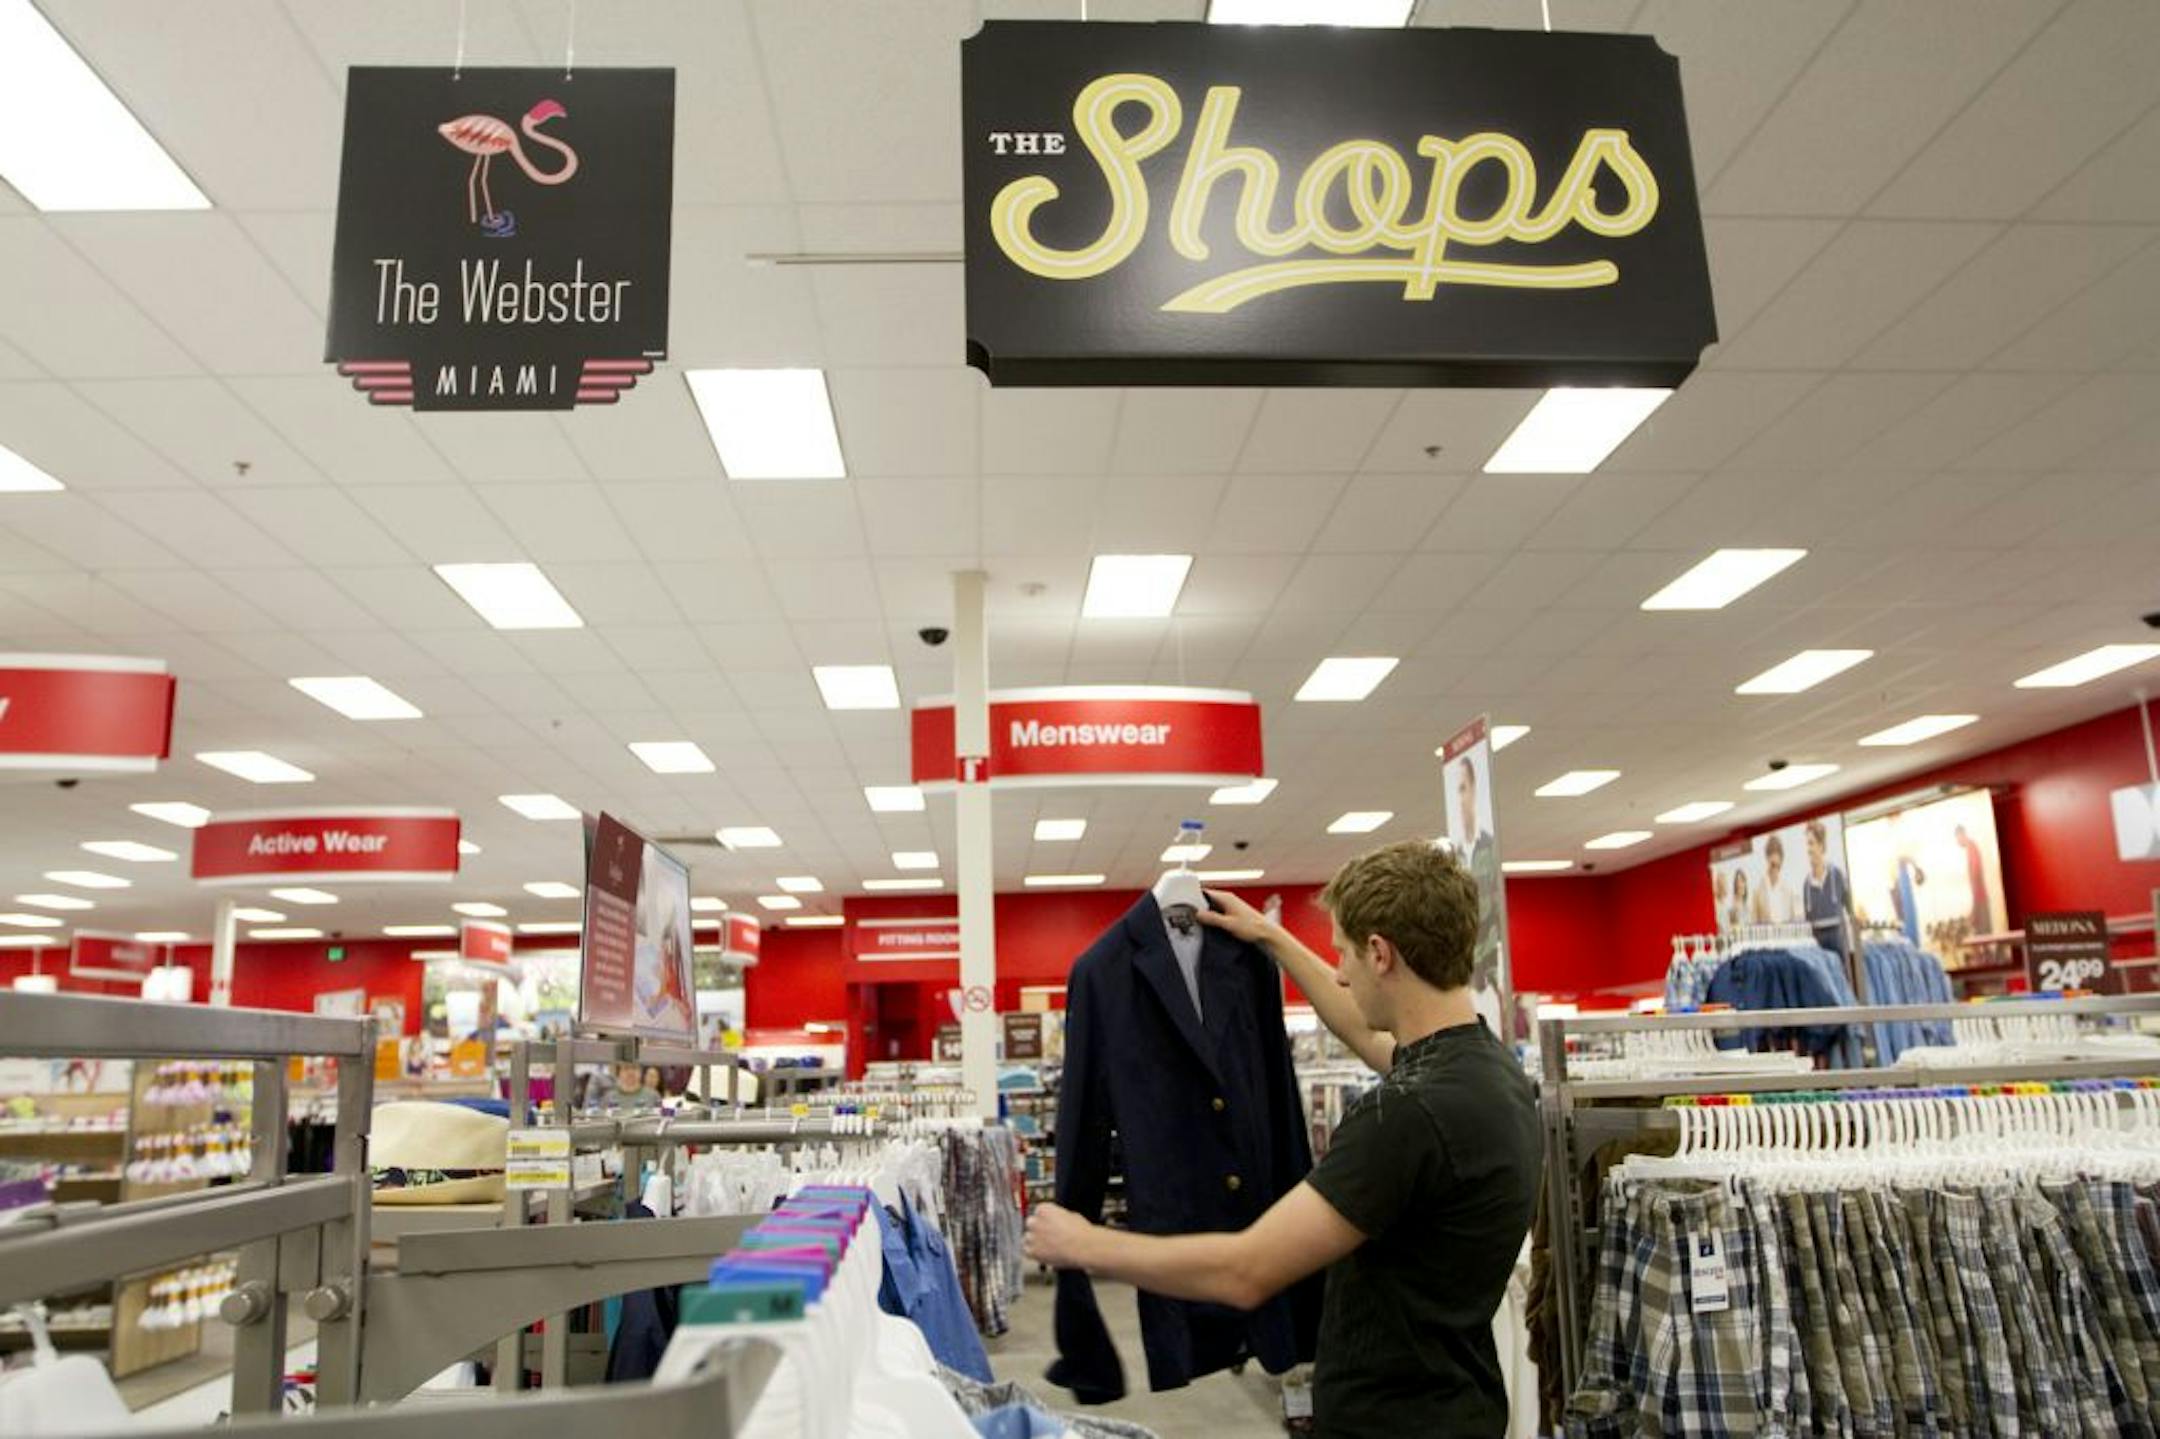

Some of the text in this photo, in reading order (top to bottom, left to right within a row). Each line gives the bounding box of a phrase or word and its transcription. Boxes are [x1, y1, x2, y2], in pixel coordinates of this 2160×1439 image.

[988, 72, 1660, 304] THE Shops
[372, 258, 633, 325] The Webster
[435, 365, 558, 396] MIAMI
[1010, 719, 1172, 748] Menswear
[248, 829, 388, 856] Active Wear
